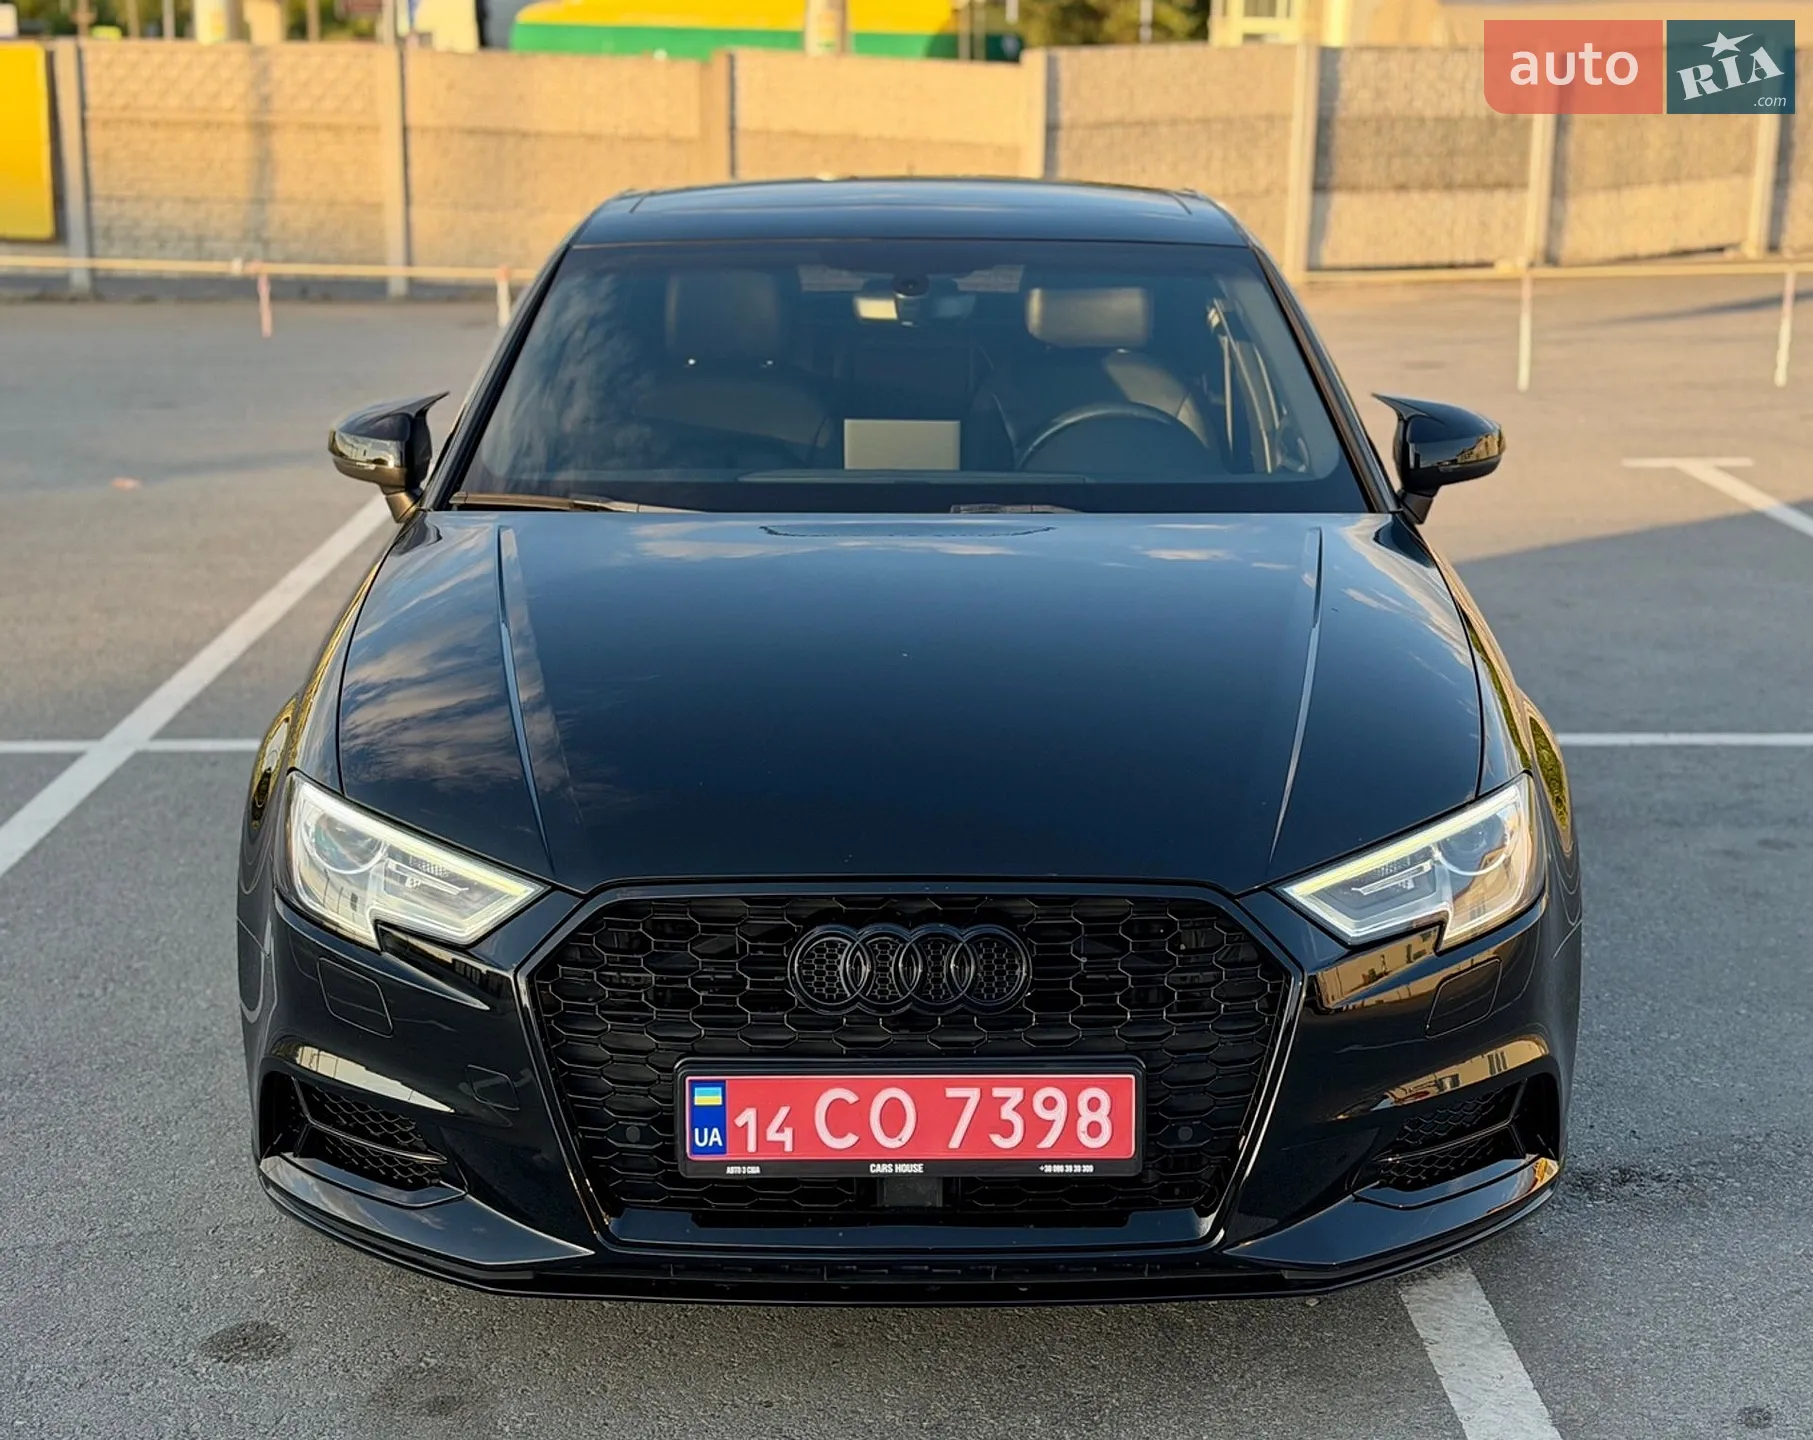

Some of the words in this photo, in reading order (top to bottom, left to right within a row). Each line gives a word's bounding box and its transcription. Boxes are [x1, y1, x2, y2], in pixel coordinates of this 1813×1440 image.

[733, 1105, 794, 1153] 14
[814, 1086, 917, 1150] CO
[945, 1086, 1113, 1150] 7398
[694, 1127, 723, 1147] UA
[869, 1163, 893, 1174] CARS
[894, 1163, 924, 1174] HOUSE
